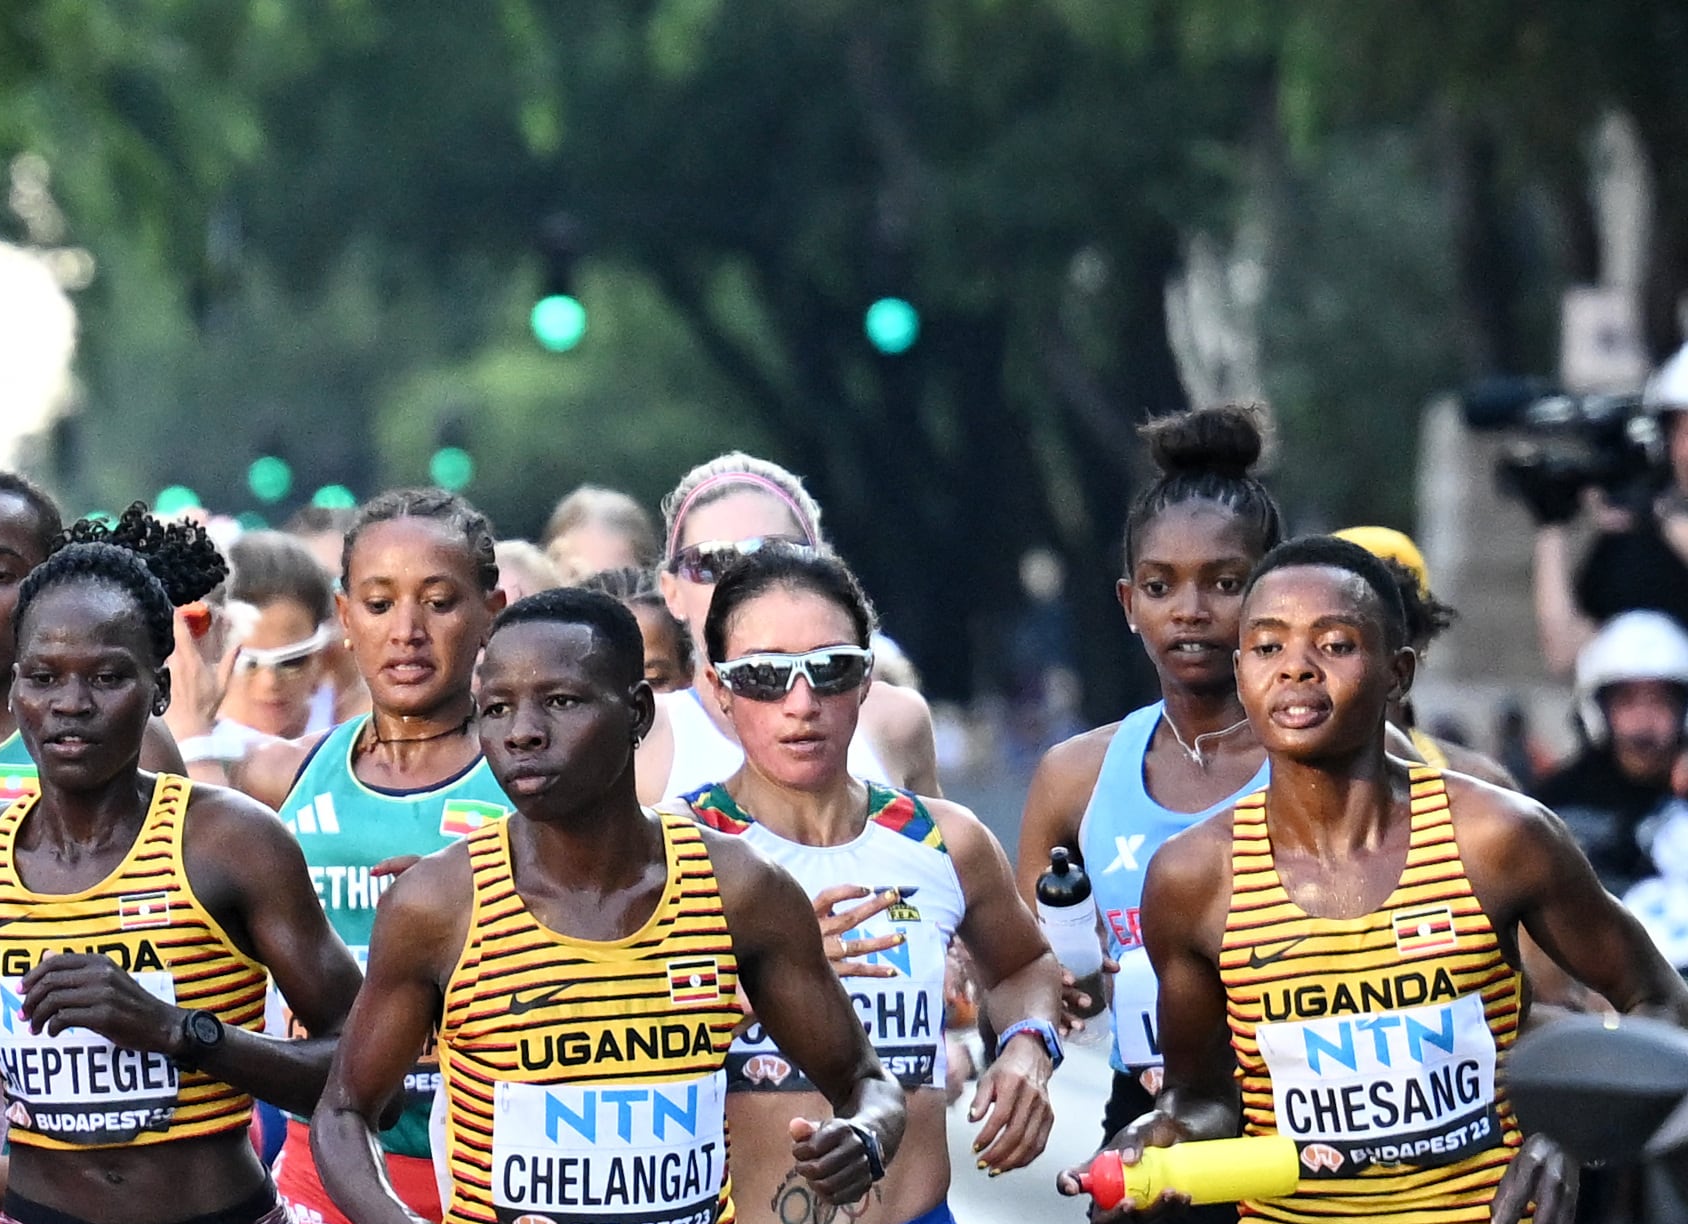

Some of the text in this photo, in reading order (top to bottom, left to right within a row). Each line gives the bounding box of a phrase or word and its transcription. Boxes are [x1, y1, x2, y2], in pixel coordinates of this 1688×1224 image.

[307, 865, 396, 910] ETHI
[852, 989, 930, 1038] CHA
[1263, 967, 1458, 1021] UGANDA
[520, 1023, 713, 1071] UGANDA
[1302, 1006, 1455, 1076] NTN
[35, 1109, 151, 1132] BUDAPEST
[545, 1085, 698, 1145] NTN
[1285, 1060, 1480, 1134] CHESANG
[1350, 1116, 1491, 1164] BUDAPEST 23
[503, 1142, 716, 1206] CHELANGAT
